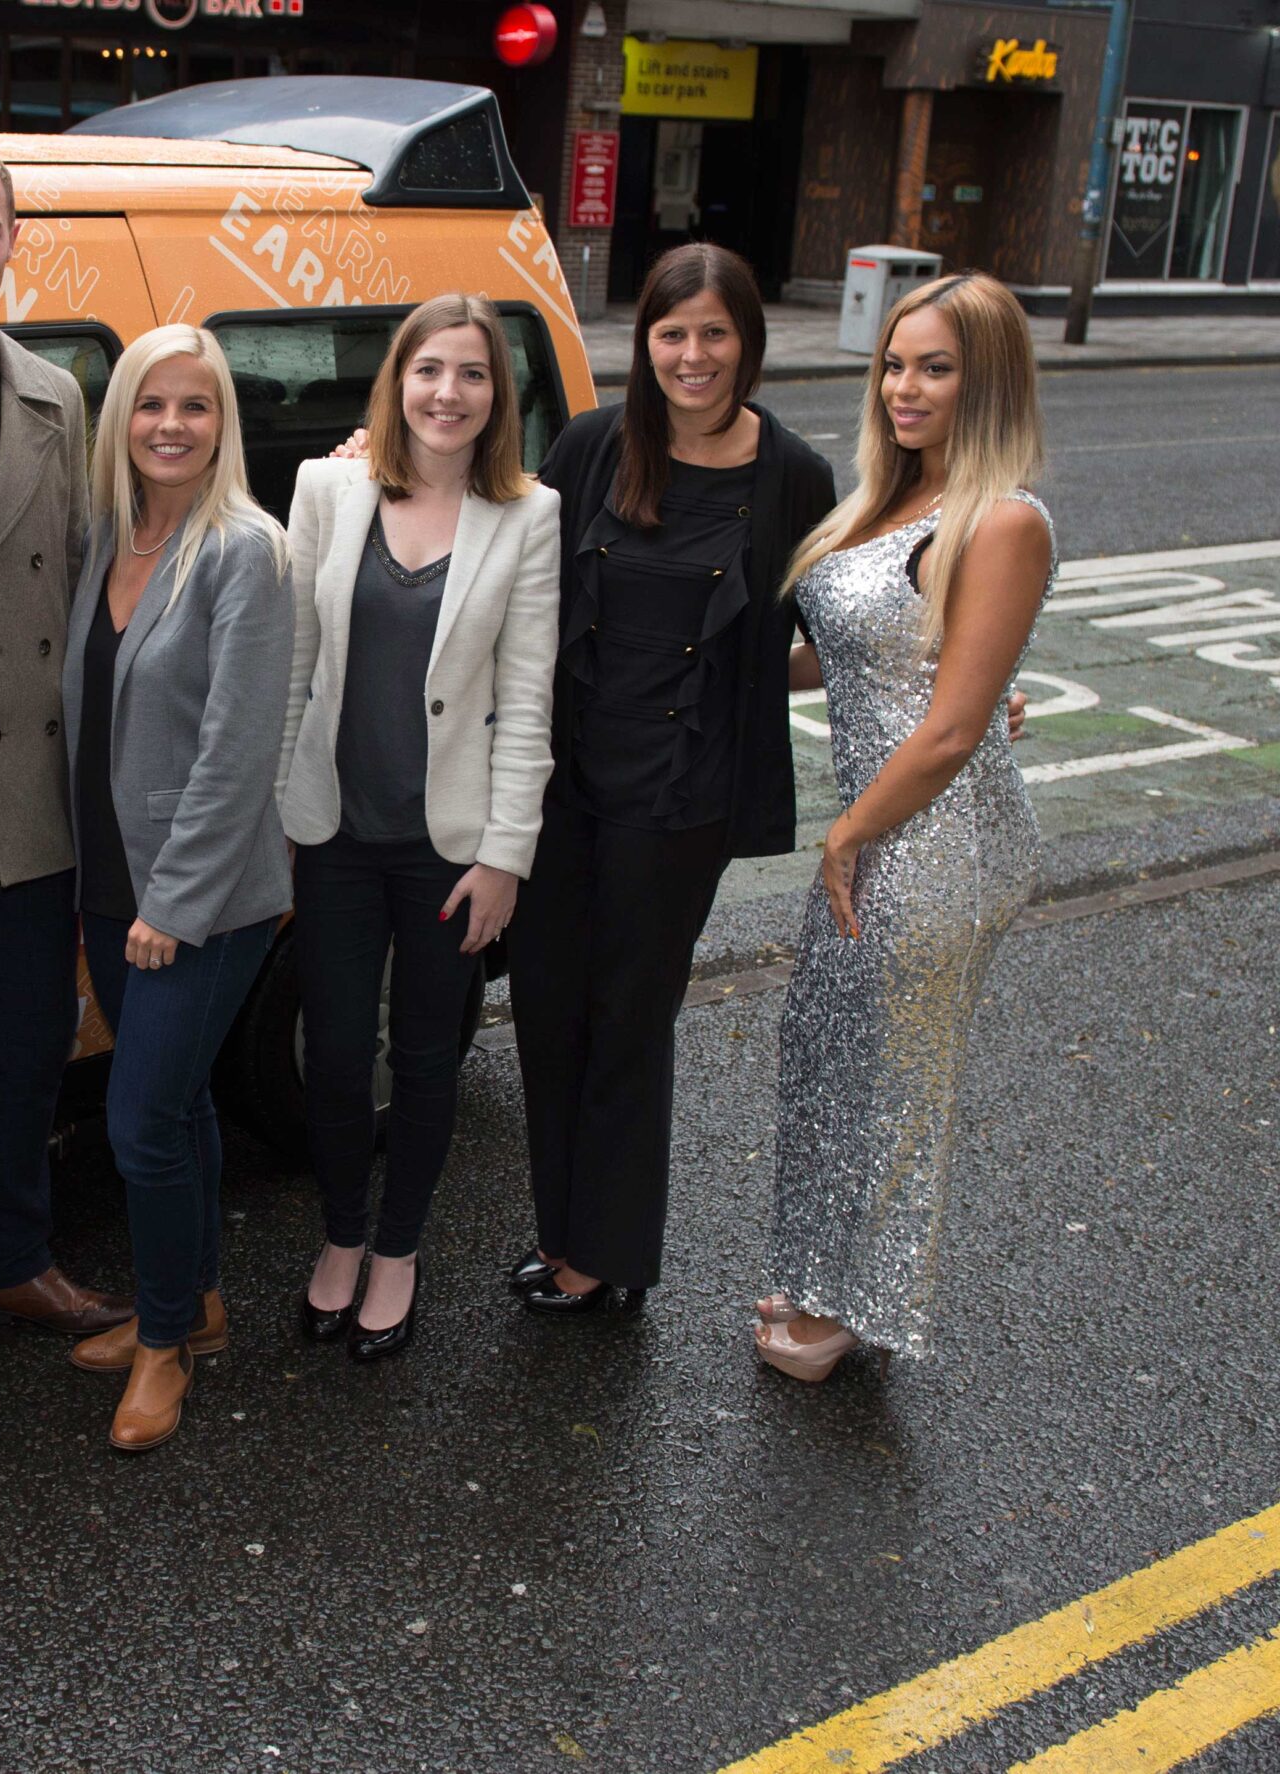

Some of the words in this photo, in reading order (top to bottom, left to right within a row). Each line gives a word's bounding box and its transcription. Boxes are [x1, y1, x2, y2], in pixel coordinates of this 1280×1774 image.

[638, 58, 661, 76] Lift
[664, 62, 690, 78] and
[693, 64, 730, 80] stairs
[637, 81, 651, 95] to
[654, 83, 674, 96] car
[676, 83, 708, 102] park
[1122, 152, 1177, 184] TOC
